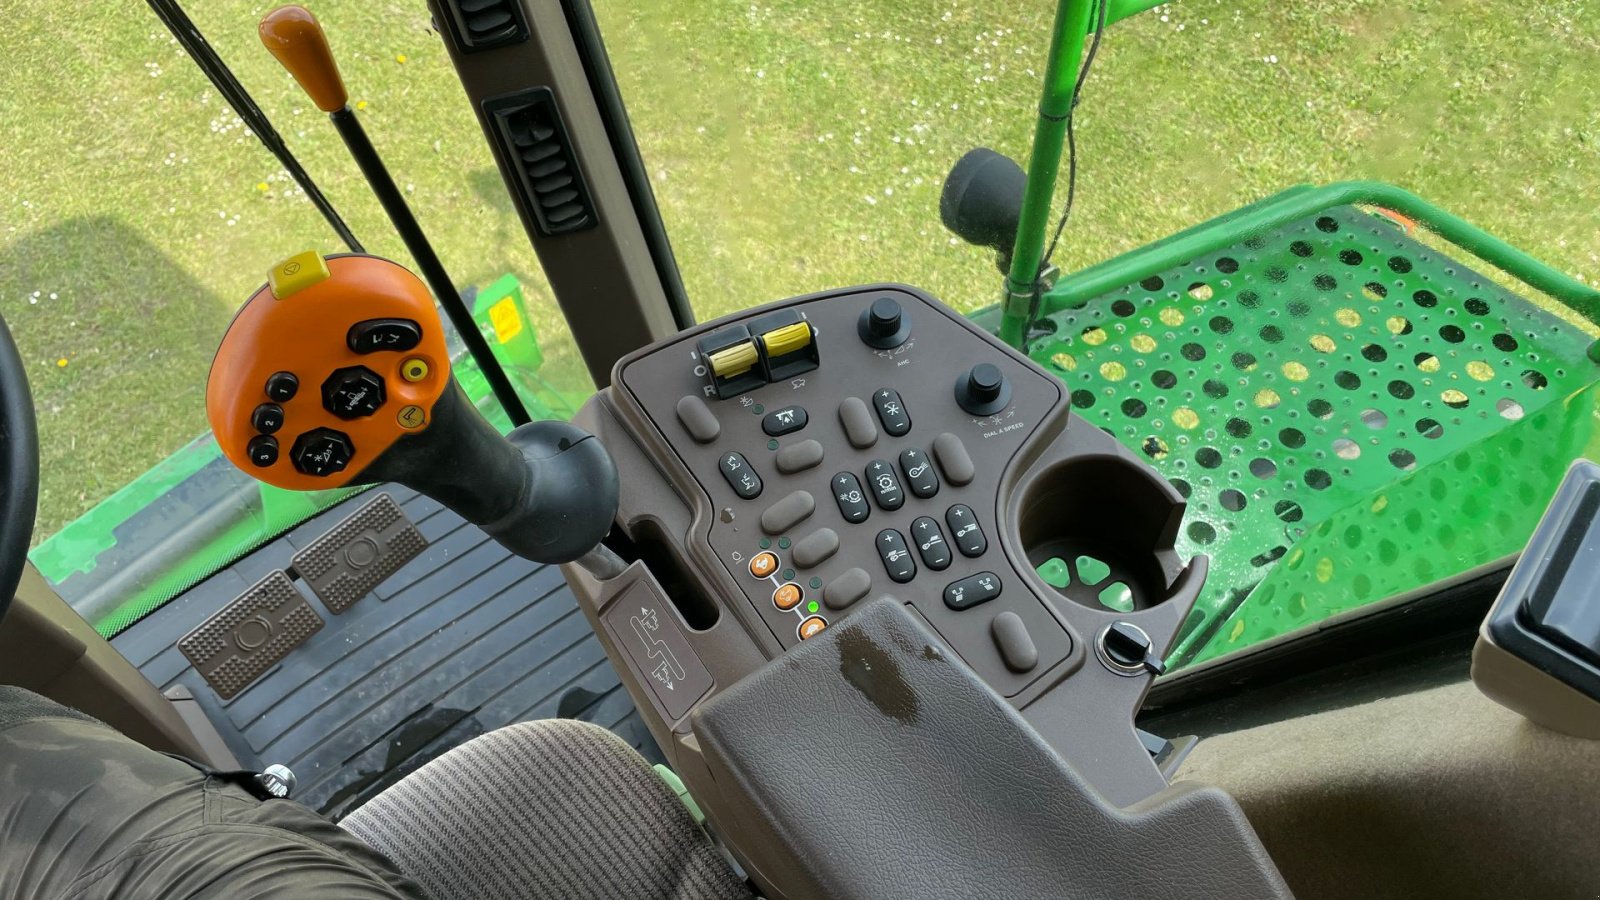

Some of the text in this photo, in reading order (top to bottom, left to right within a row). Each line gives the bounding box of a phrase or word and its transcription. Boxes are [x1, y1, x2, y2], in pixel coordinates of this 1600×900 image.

[897, 359, 910, 367] AHC
[703, 384, 717, 397] R
[983, 430, 998, 439] DIAL
[1003, 422, 1024, 432] SPEED
